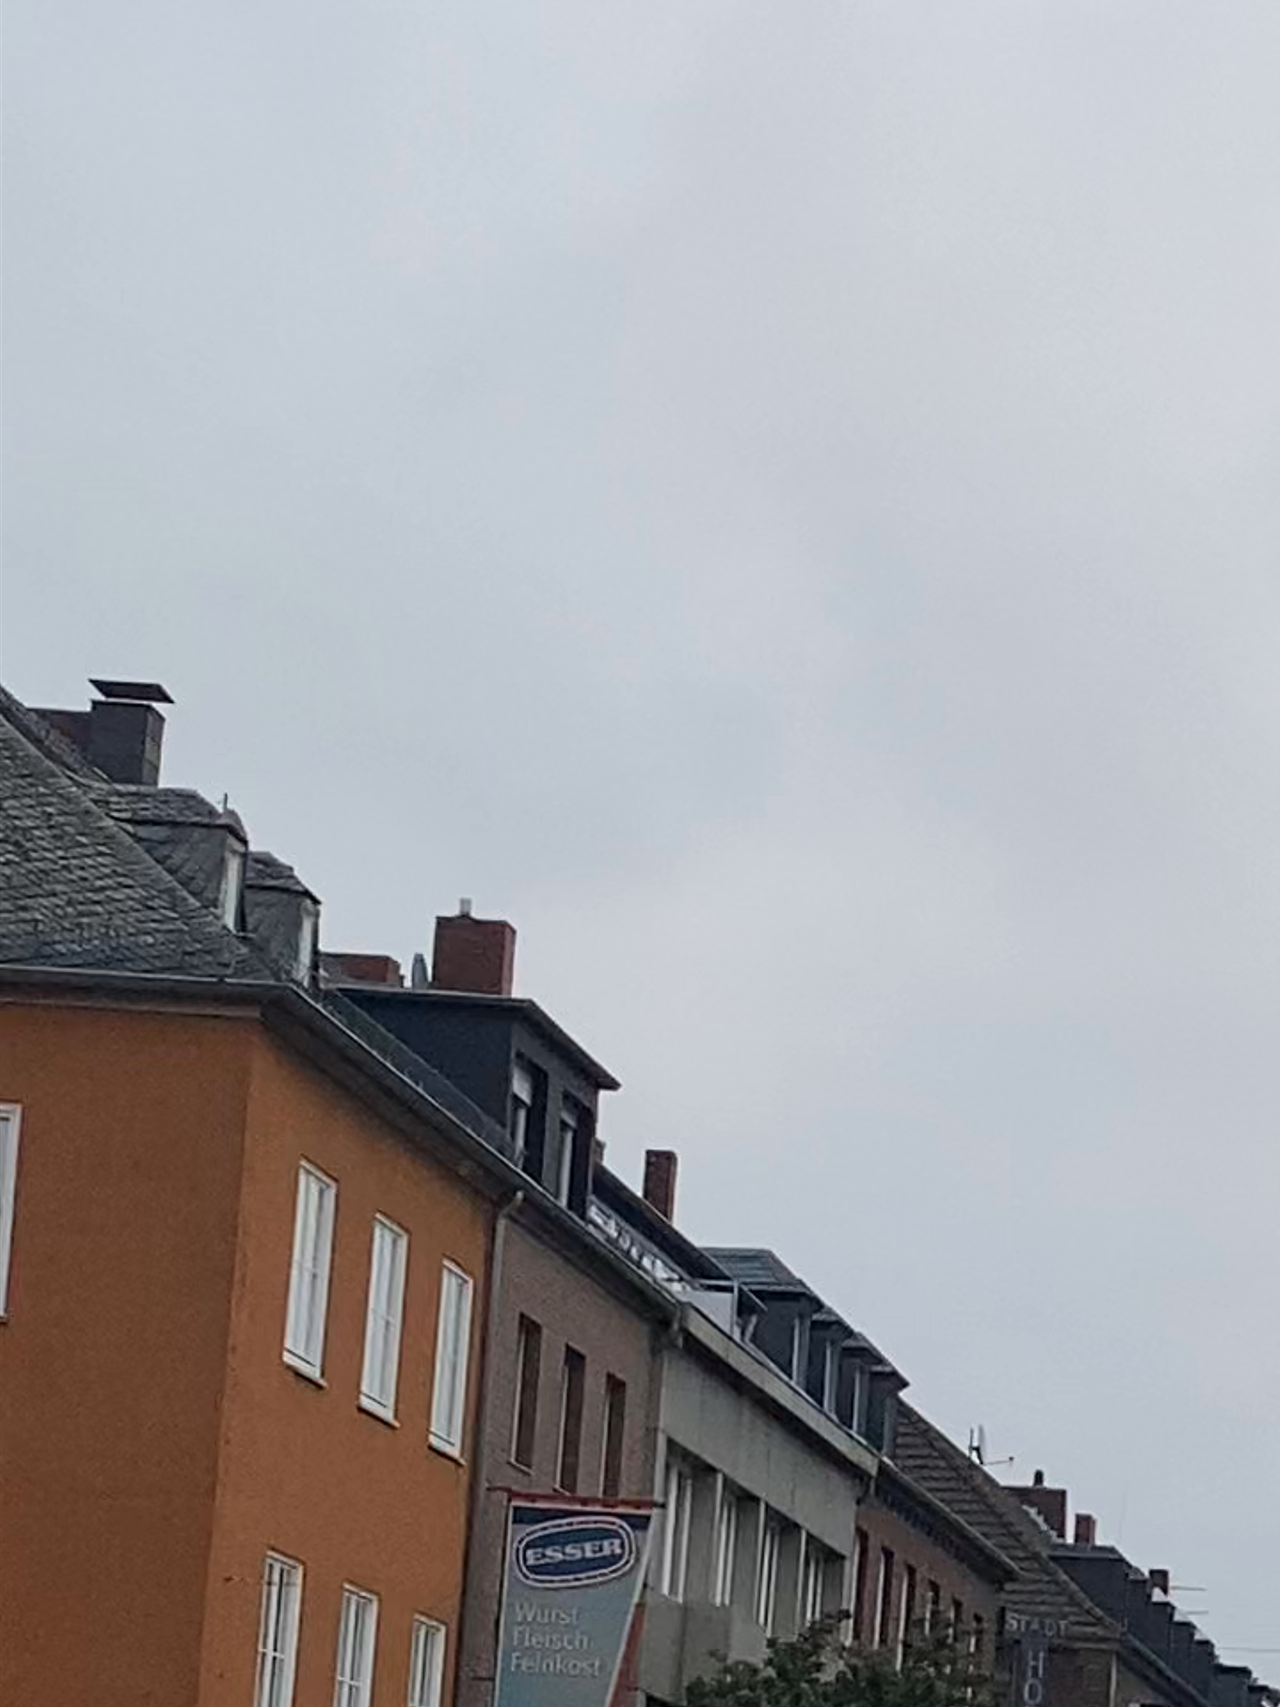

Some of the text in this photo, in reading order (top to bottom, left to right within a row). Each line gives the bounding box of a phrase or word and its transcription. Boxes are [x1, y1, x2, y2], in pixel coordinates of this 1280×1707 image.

[526, 1538, 623, 1566] ESSER
[515, 1603, 579, 1625] Wurst
[513, 1625, 589, 1651] Fleisch
[510, 1652, 601, 1677] Feinkost
